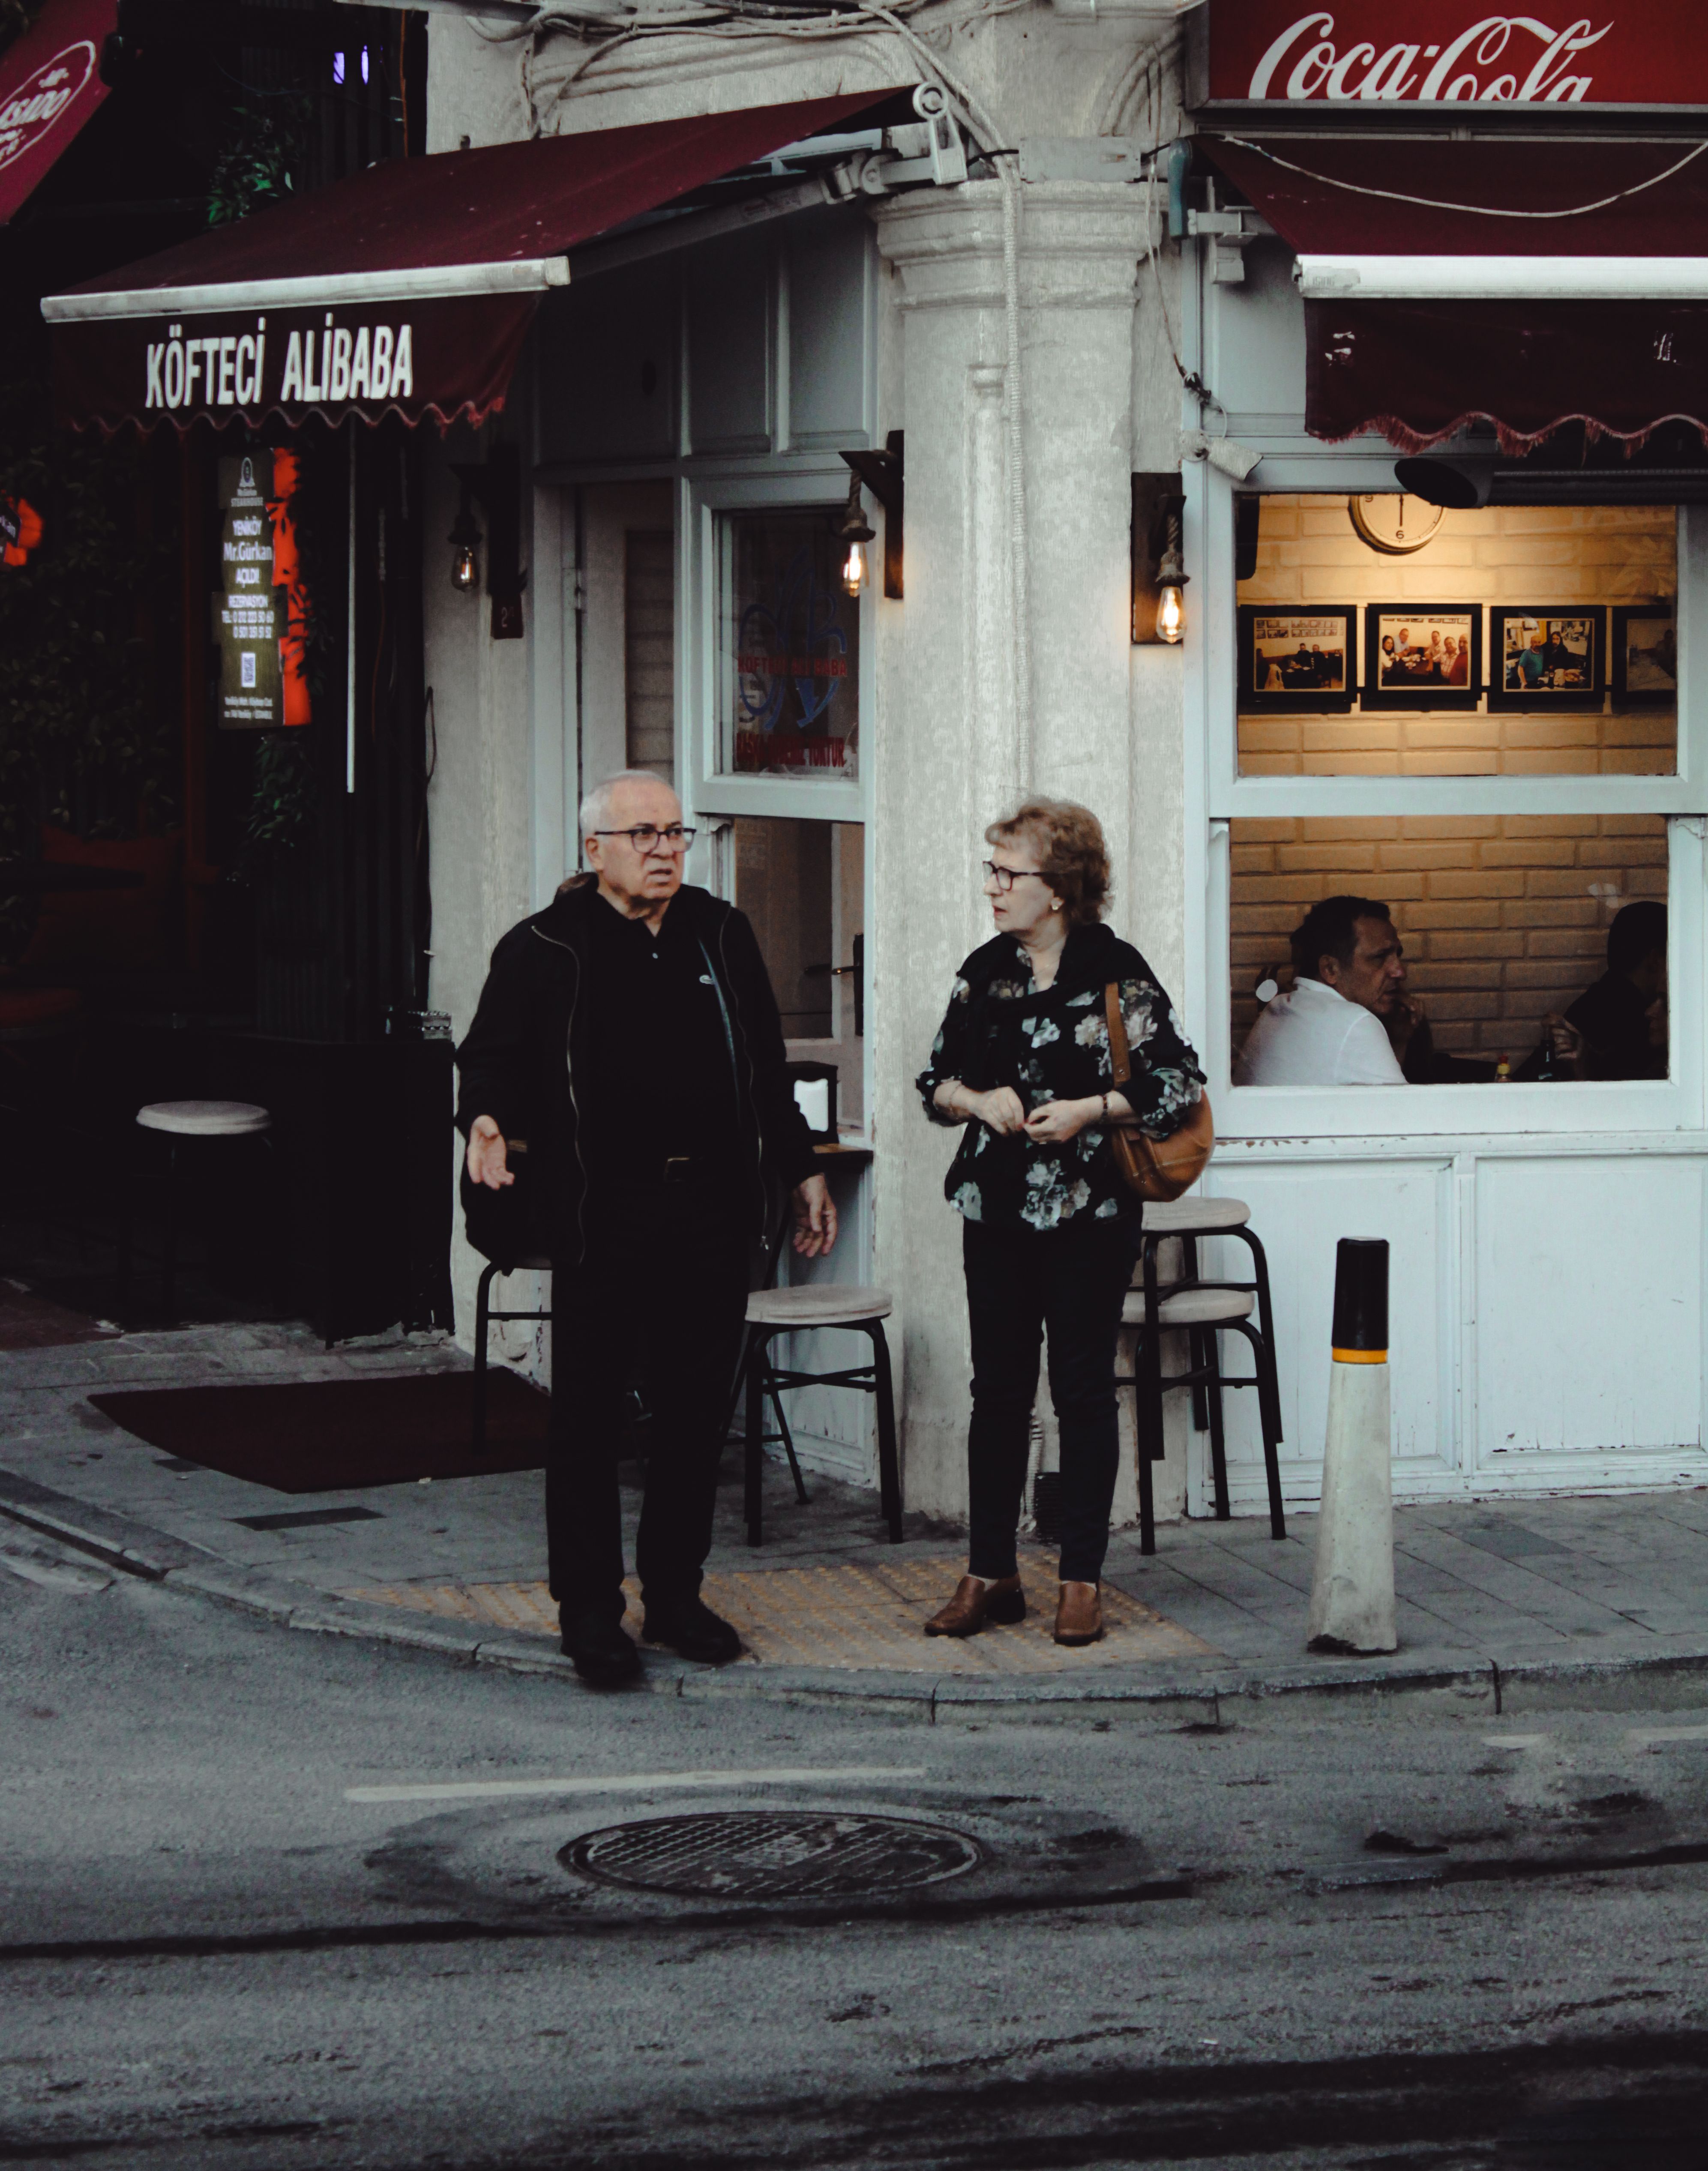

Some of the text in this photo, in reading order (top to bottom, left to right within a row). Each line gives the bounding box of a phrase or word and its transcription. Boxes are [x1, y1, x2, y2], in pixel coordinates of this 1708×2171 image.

[145, 312, 413, 409] KÖFTECİ ALİBABA
[1396, 530, 1405, 539] 6
